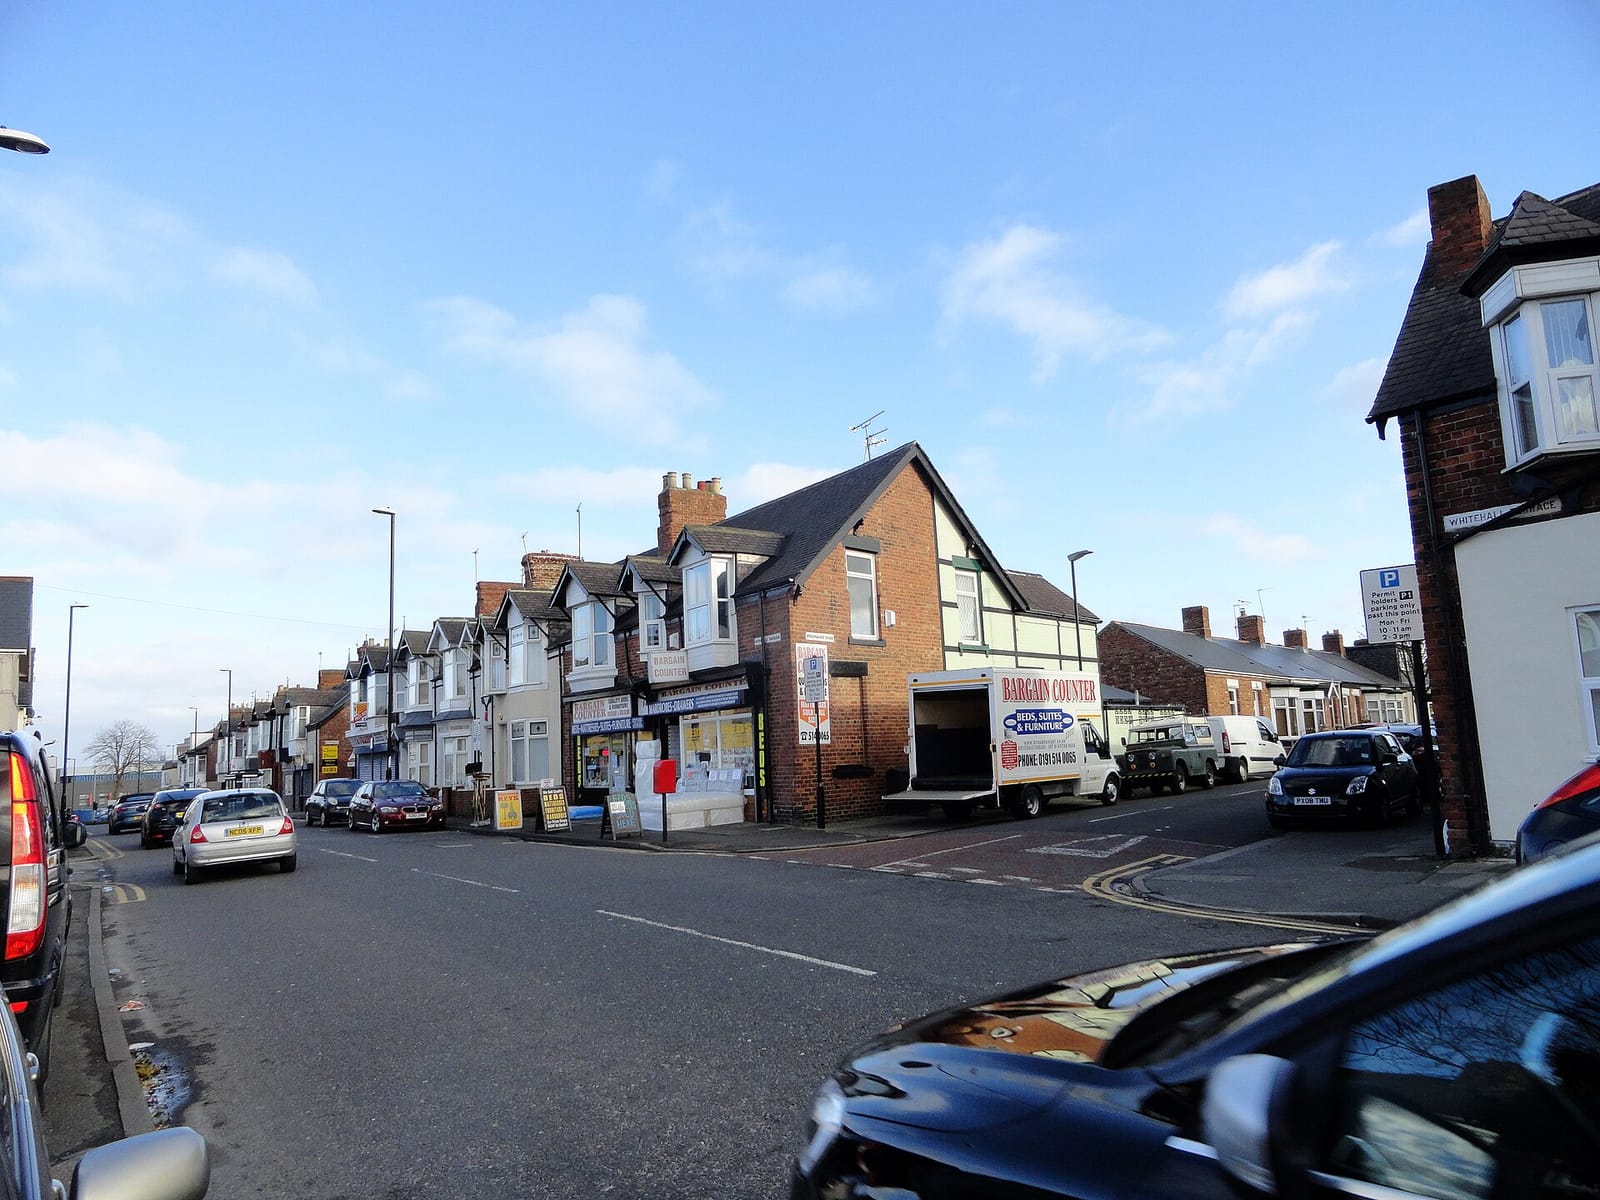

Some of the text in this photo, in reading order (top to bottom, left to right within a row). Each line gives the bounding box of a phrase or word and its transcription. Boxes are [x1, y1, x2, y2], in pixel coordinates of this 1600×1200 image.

[1384, 571, 1397, 587] P
[1371, 604, 1398, 612] parking
[654, 656, 685, 665] BARGAIN
[654, 667, 687, 677] COUNTER
[661, 680, 746, 697] BARGAIN COUNTE
[1002, 677, 1097, 702] BARGAIN COUNTER
[574, 700, 605, 712] BARGAIN
[574, 708, 607, 720] COUNTER
[1016, 711, 1063, 721] BEDS, SUITES
[1024, 722, 1064, 731] FURNITURE
[1018, 753, 1038, 767] PHONE:
[1038, 753, 1051, 765] 0191
[1052, 752, 1061, 765] 514
[1061, 751, 1077, 764] 0065
